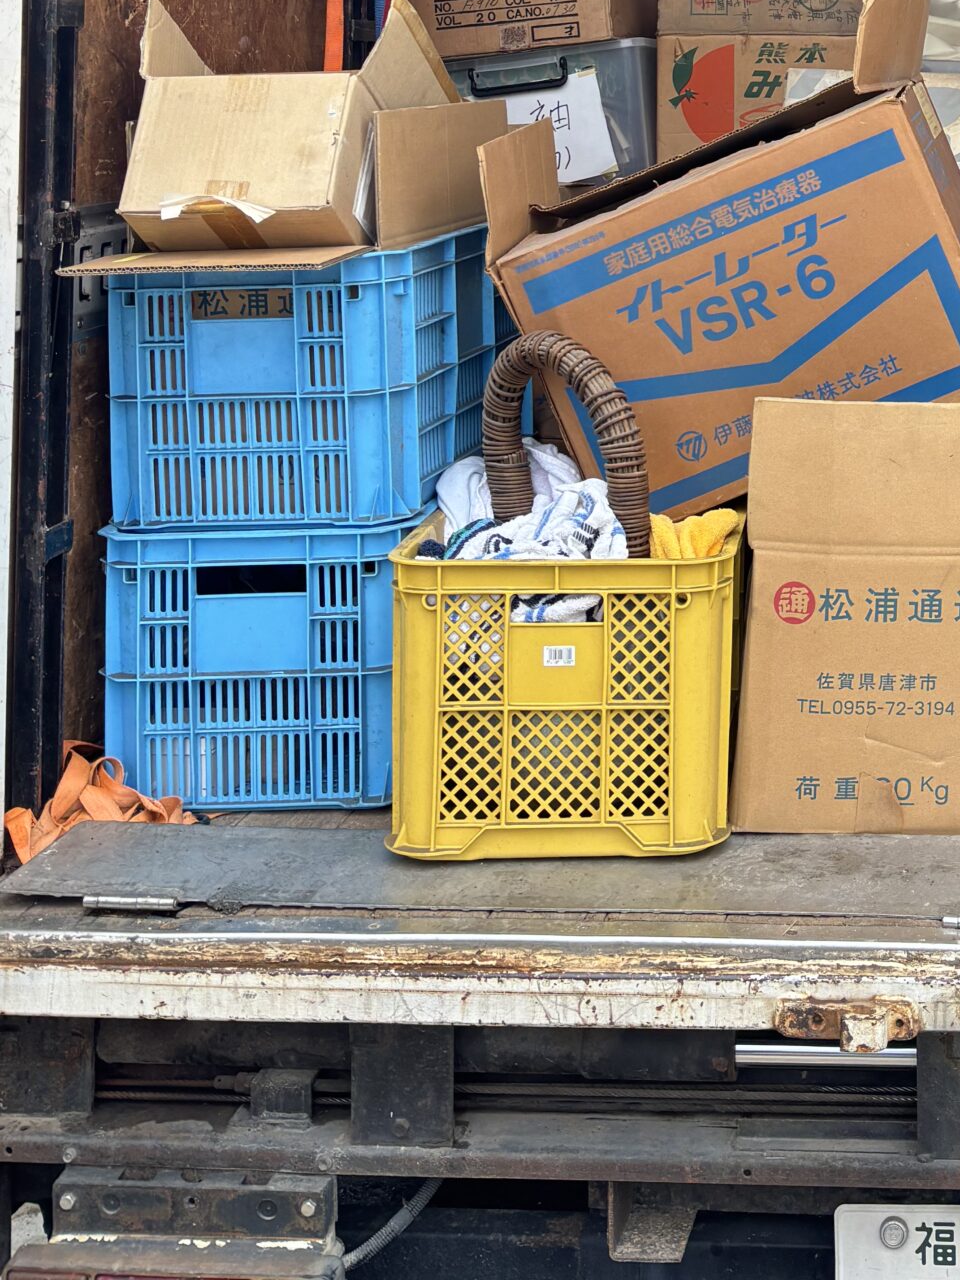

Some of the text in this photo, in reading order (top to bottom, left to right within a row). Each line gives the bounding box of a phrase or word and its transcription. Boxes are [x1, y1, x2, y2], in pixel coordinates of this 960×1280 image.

[755, 42, 827, 64] 熊本
[603, 168, 822, 276] 家庭用総合電気治療器
[616, 213, 848, 323] イトーレーター
[655, 254, 836, 356] VSR-6
[816, 672, 938, 692] 佐賀県唐津市
[797, 698, 955, 717] TEL0955-72-3194
[795, 776, 859, 801] 荷重
